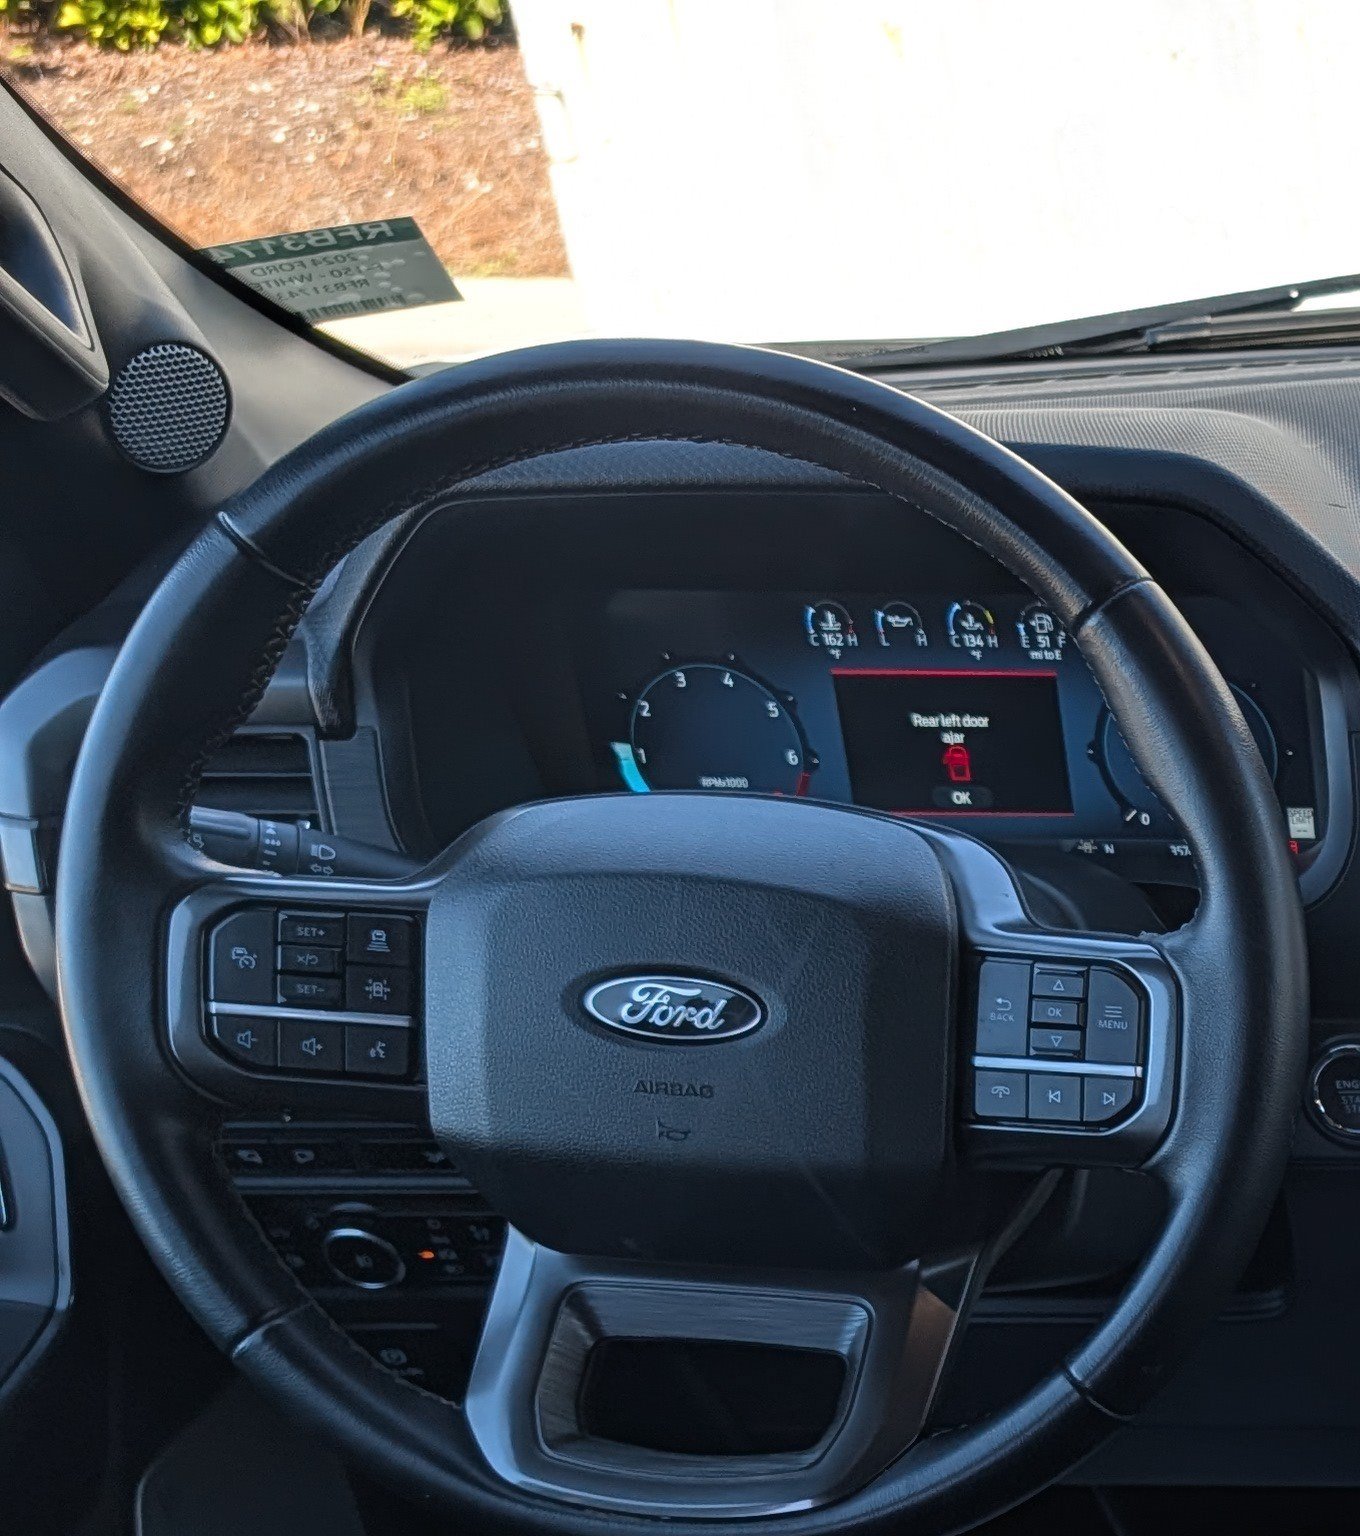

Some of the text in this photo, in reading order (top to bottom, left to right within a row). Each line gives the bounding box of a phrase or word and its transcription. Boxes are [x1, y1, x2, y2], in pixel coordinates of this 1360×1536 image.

[809, 634, 859, 647] C 162 H
[880, 634, 927, 647] L H
[950, 634, 998, 648] C 134 H
[1020, 635, 1067, 648] E 51 F
[675, 671, 686, 687] 3
[723, 672, 734, 687] 4
[639, 700, 651, 717] 2
[766, 701, 779, 718] 5
[911, 713, 989, 728] Rear left door
[941, 731, 966, 745] ajar
[637, 747, 647, 764] 1
[785, 750, 799, 765] 6
[952, 791, 972, 805] OK
[1140, 813, 1151, 826] 0
[1104, 844, 1115, 854] N
[620, 983, 727, 1031] Ford
[1047, 1007, 1062, 1017] OK
[989, 1012, 1015, 1022] BACK
[1098, 1019, 1128, 1030] MENU
[634, 1079, 715, 1098] AIRBAG
